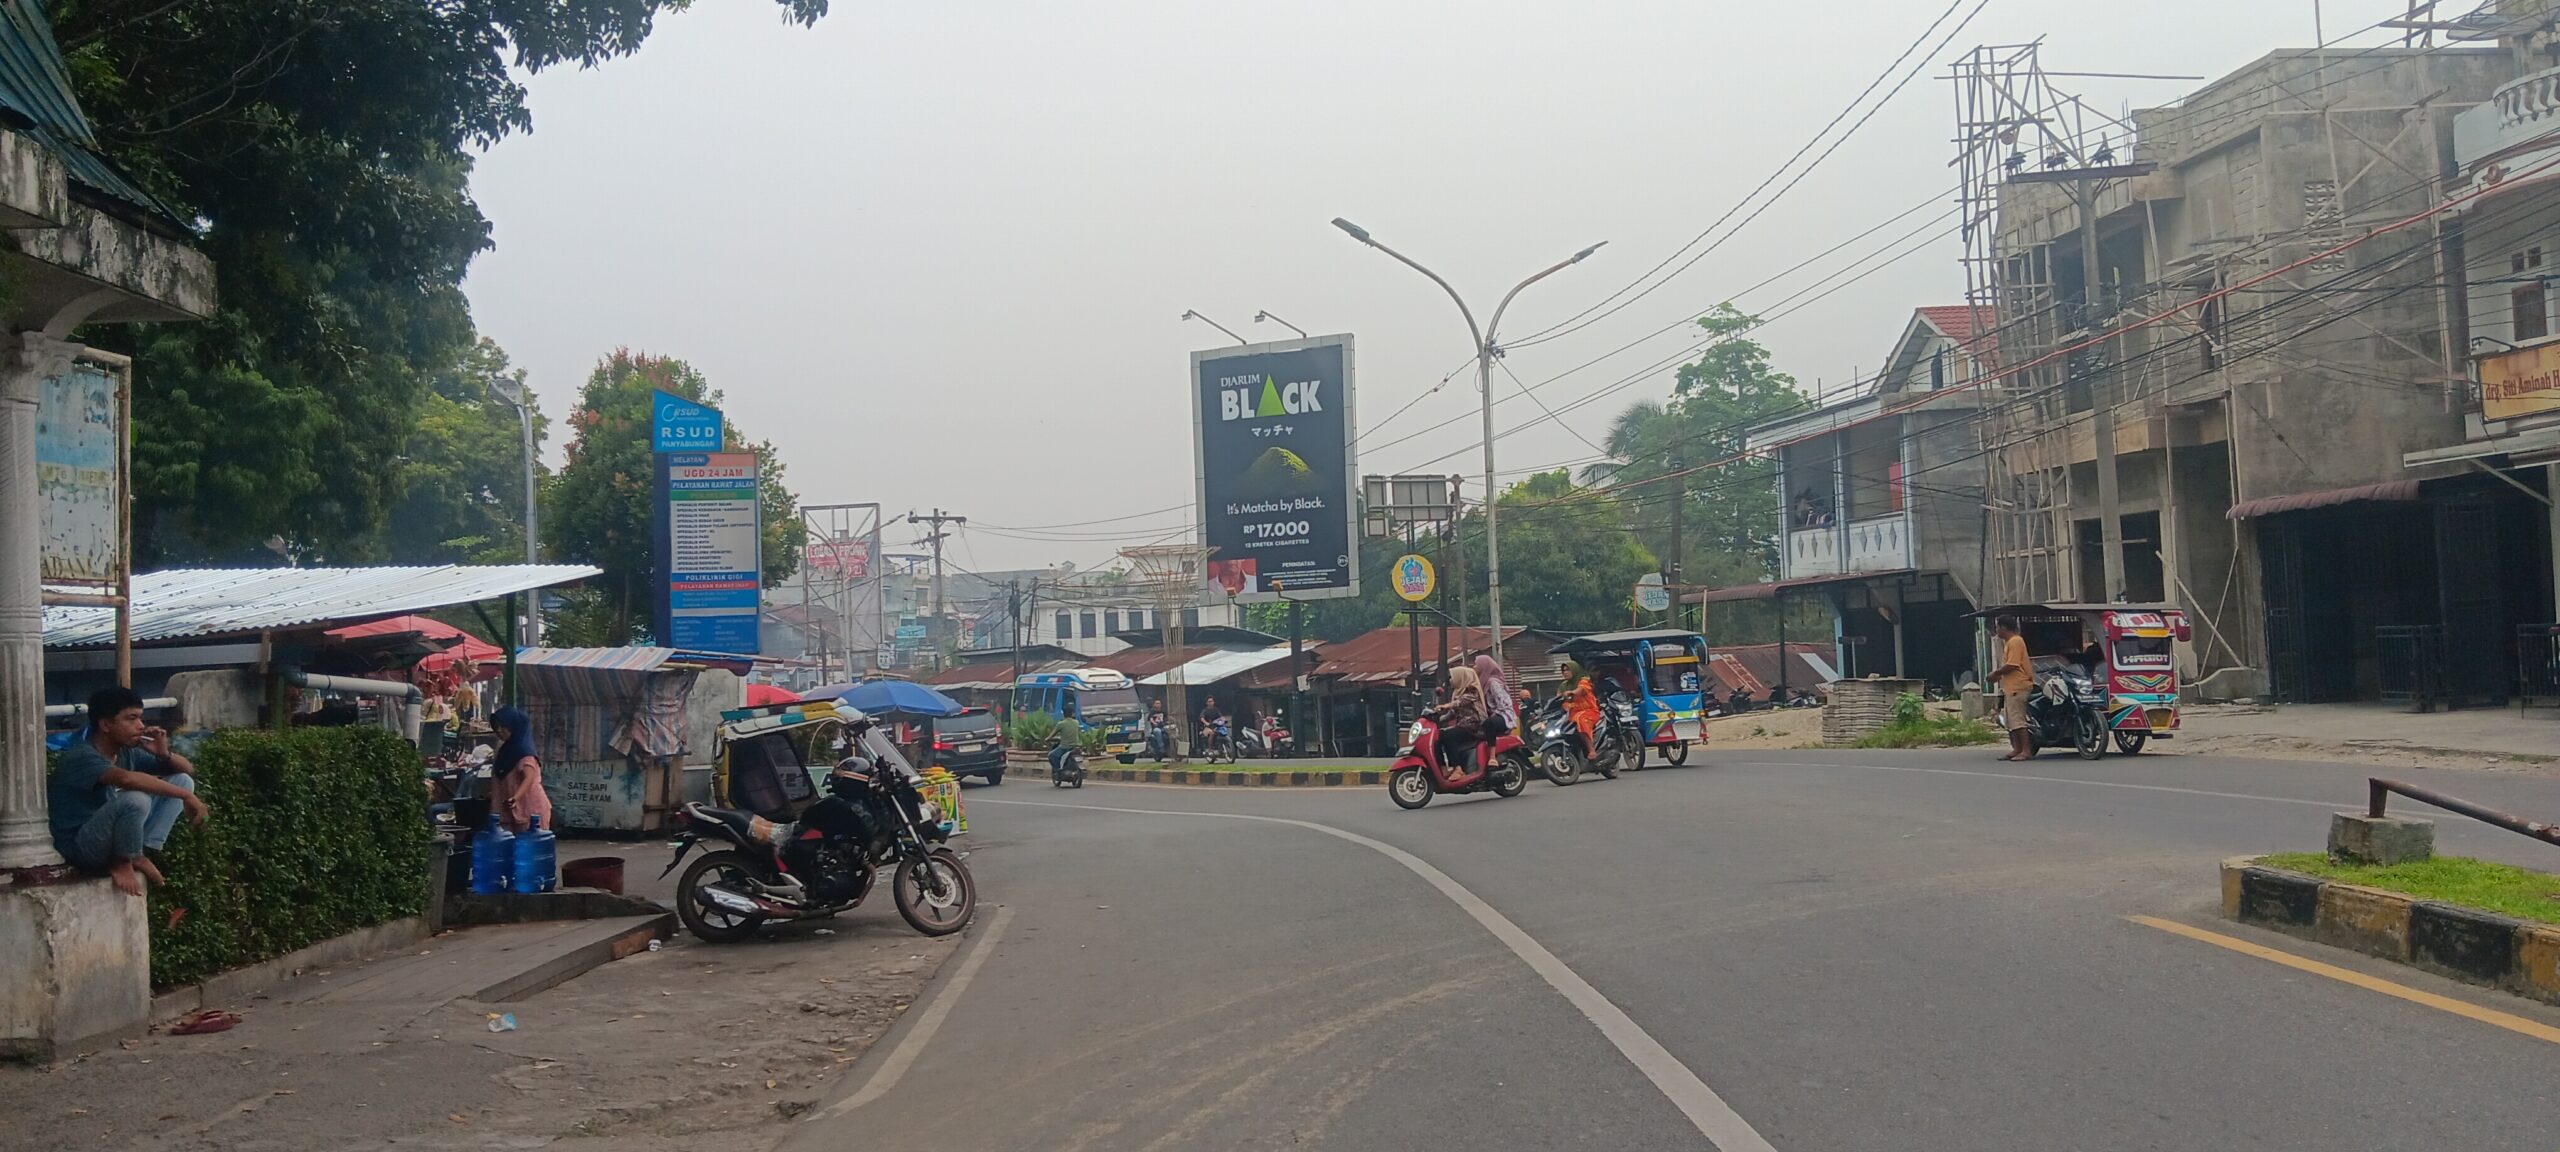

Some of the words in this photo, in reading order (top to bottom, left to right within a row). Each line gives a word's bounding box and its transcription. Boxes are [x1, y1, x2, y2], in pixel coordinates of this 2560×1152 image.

[1220, 374, 1260, 387] DJARUM
[2519, 372, 2551, 394] Aminah
[661, 427, 716, 438] RSUD
[1251, 424, 1294, 437] マッチャ
[684, 469, 705, 478] UGD
[708, 469, 720, 477] 24
[722, 469, 743, 477] JAM
[1227, 503, 1240, 516] It's
[1240, 500, 1279, 514] Matcha
[1280, 499, 1294, 514] by
[1294, 497, 1325, 510] Black.
[1243, 525, 1256, 534] RP
[1257, 520, 1310, 538] 17.000
[1275, 539, 1310, 547] CIGARETTES
[568, 782, 588, 791] SATE
[589, 783, 608, 792] SAPI
[567, 793, 588, 801] SATE
[589, 794, 611, 802] AYAM
